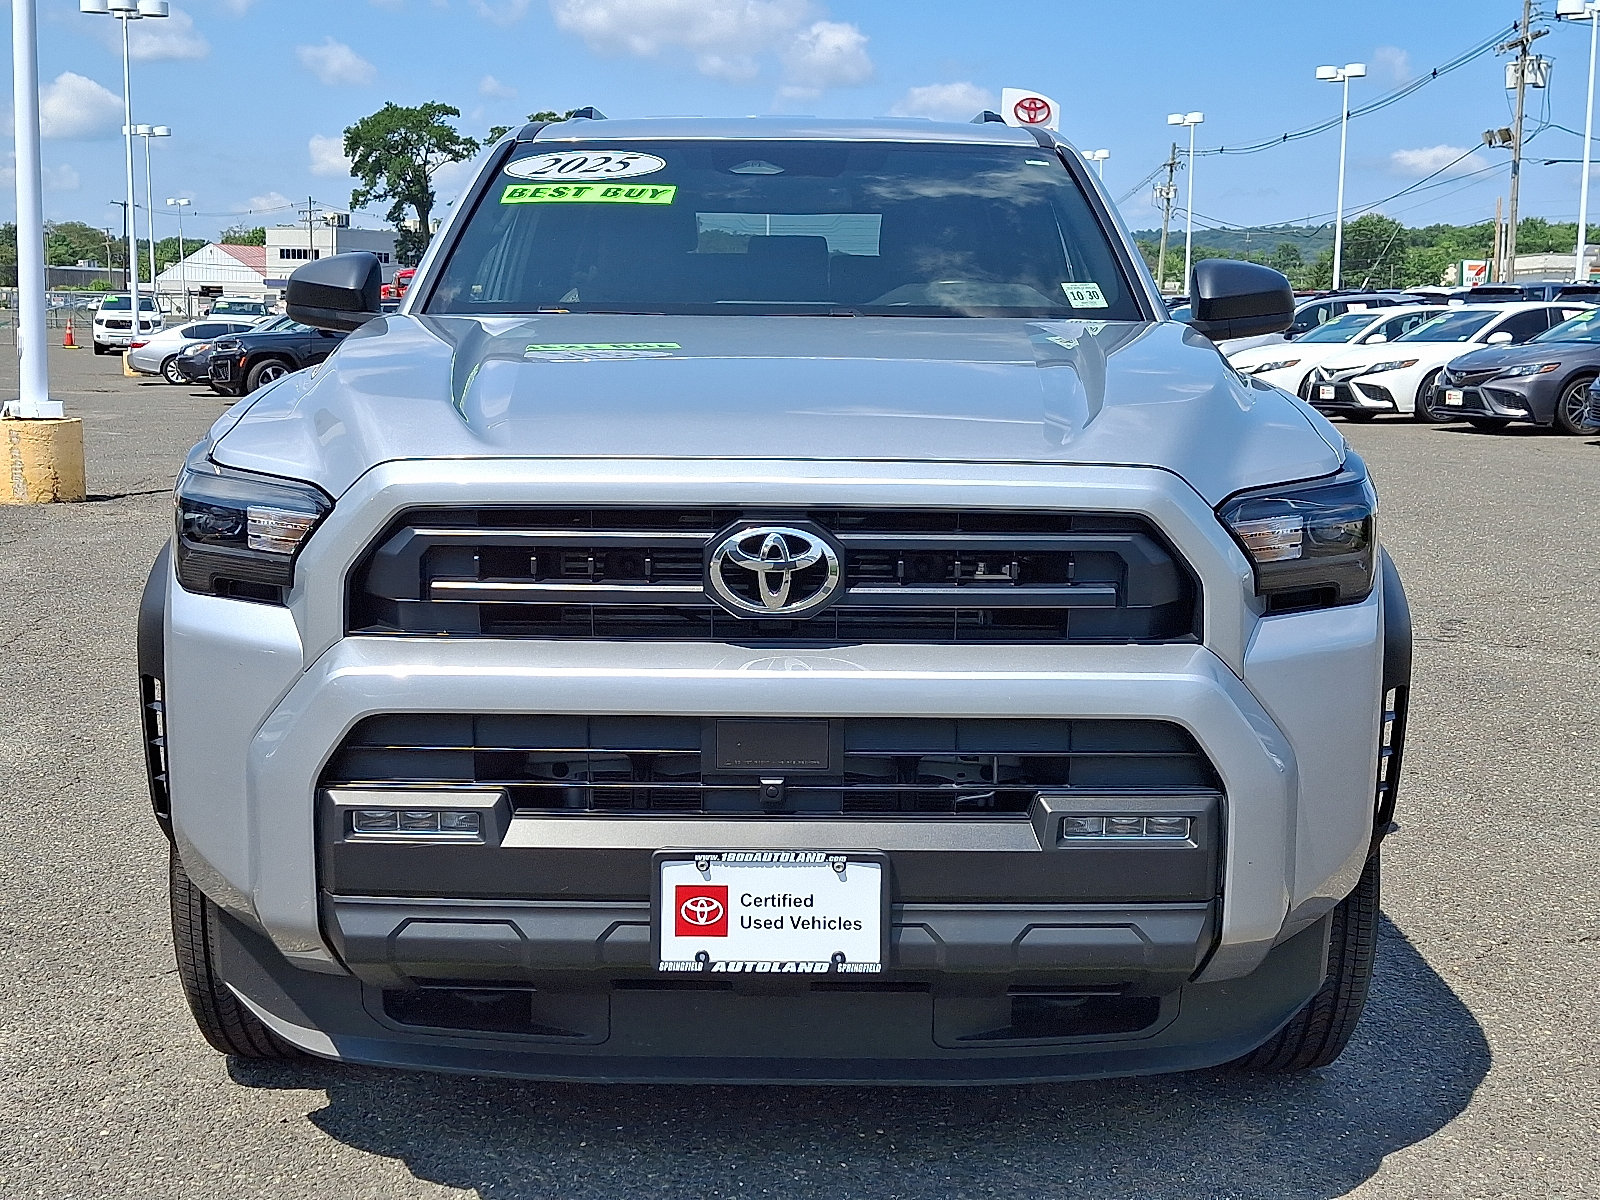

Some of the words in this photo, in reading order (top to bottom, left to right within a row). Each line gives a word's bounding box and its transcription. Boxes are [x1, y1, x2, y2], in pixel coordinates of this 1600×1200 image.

[527, 156, 641, 175] 2025
[506, 186, 593, 199] BEST
[600, 187, 671, 199] BUY
[1070, 291, 1084, 300] 10
[1086, 291, 1099, 300] 30
[740, 893, 814, 908] Certified
[740, 915, 784, 930] Used
[790, 915, 862, 931] Vehicles
[659, 961, 703, 972] SPRINGFIELD
[711, 961, 830, 973] AUTOLAND
[837, 963, 882, 973] SPRINGFIELD
